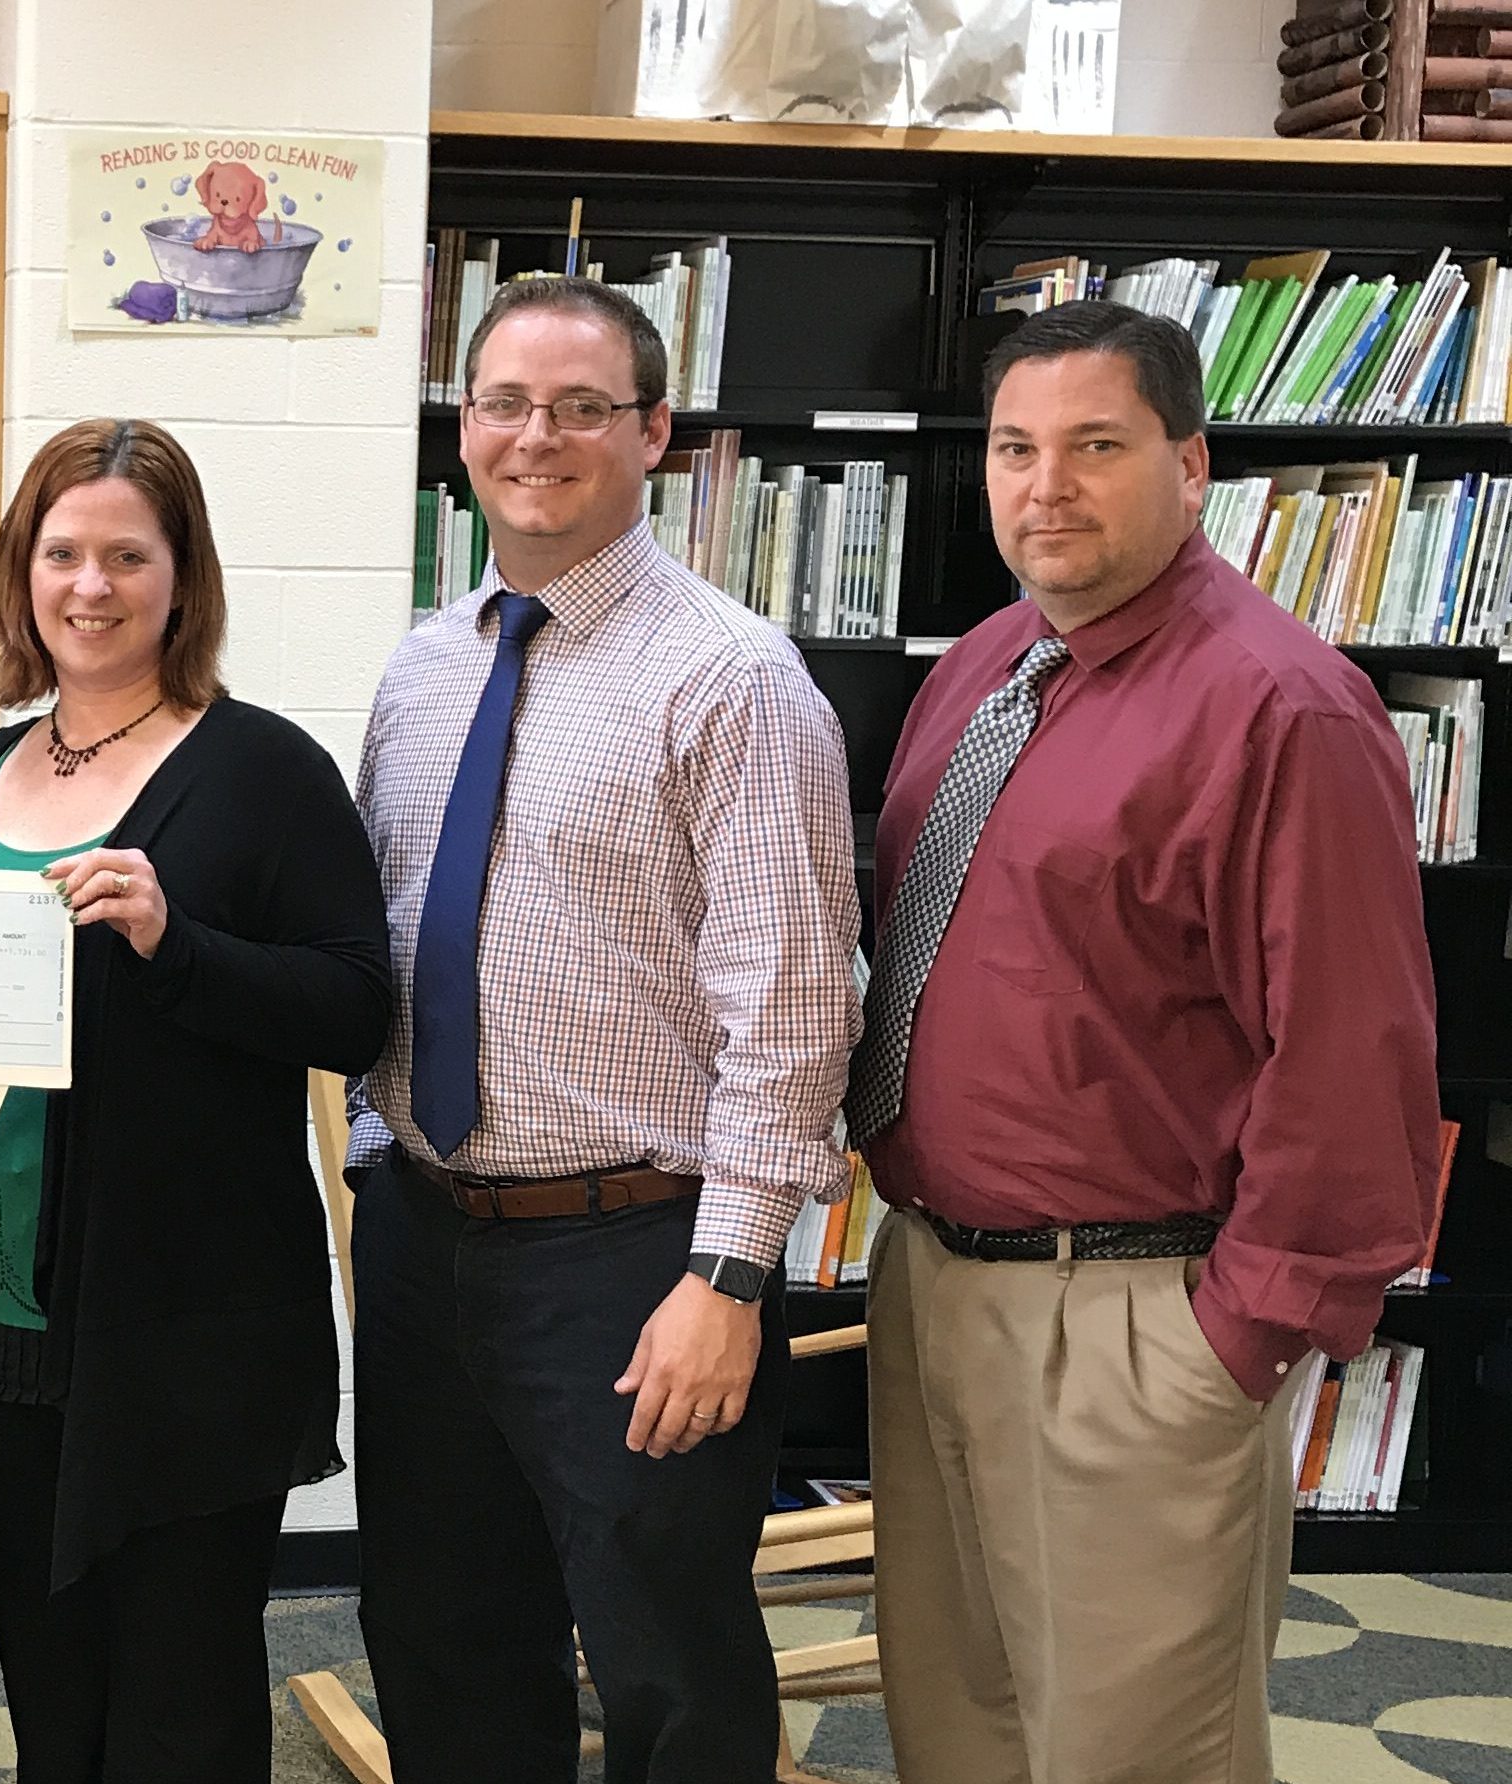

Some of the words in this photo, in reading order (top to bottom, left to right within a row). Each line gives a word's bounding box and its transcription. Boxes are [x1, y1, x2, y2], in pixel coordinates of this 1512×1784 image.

[101, 143, 178, 173] READING
[184, 141, 200, 160] IS
[206, 141, 260, 160] GOOD
[265, 144, 319, 171] CLEAN
[323, 155, 358, 182] FUN!
[29, 895, 57, 905] 2137
